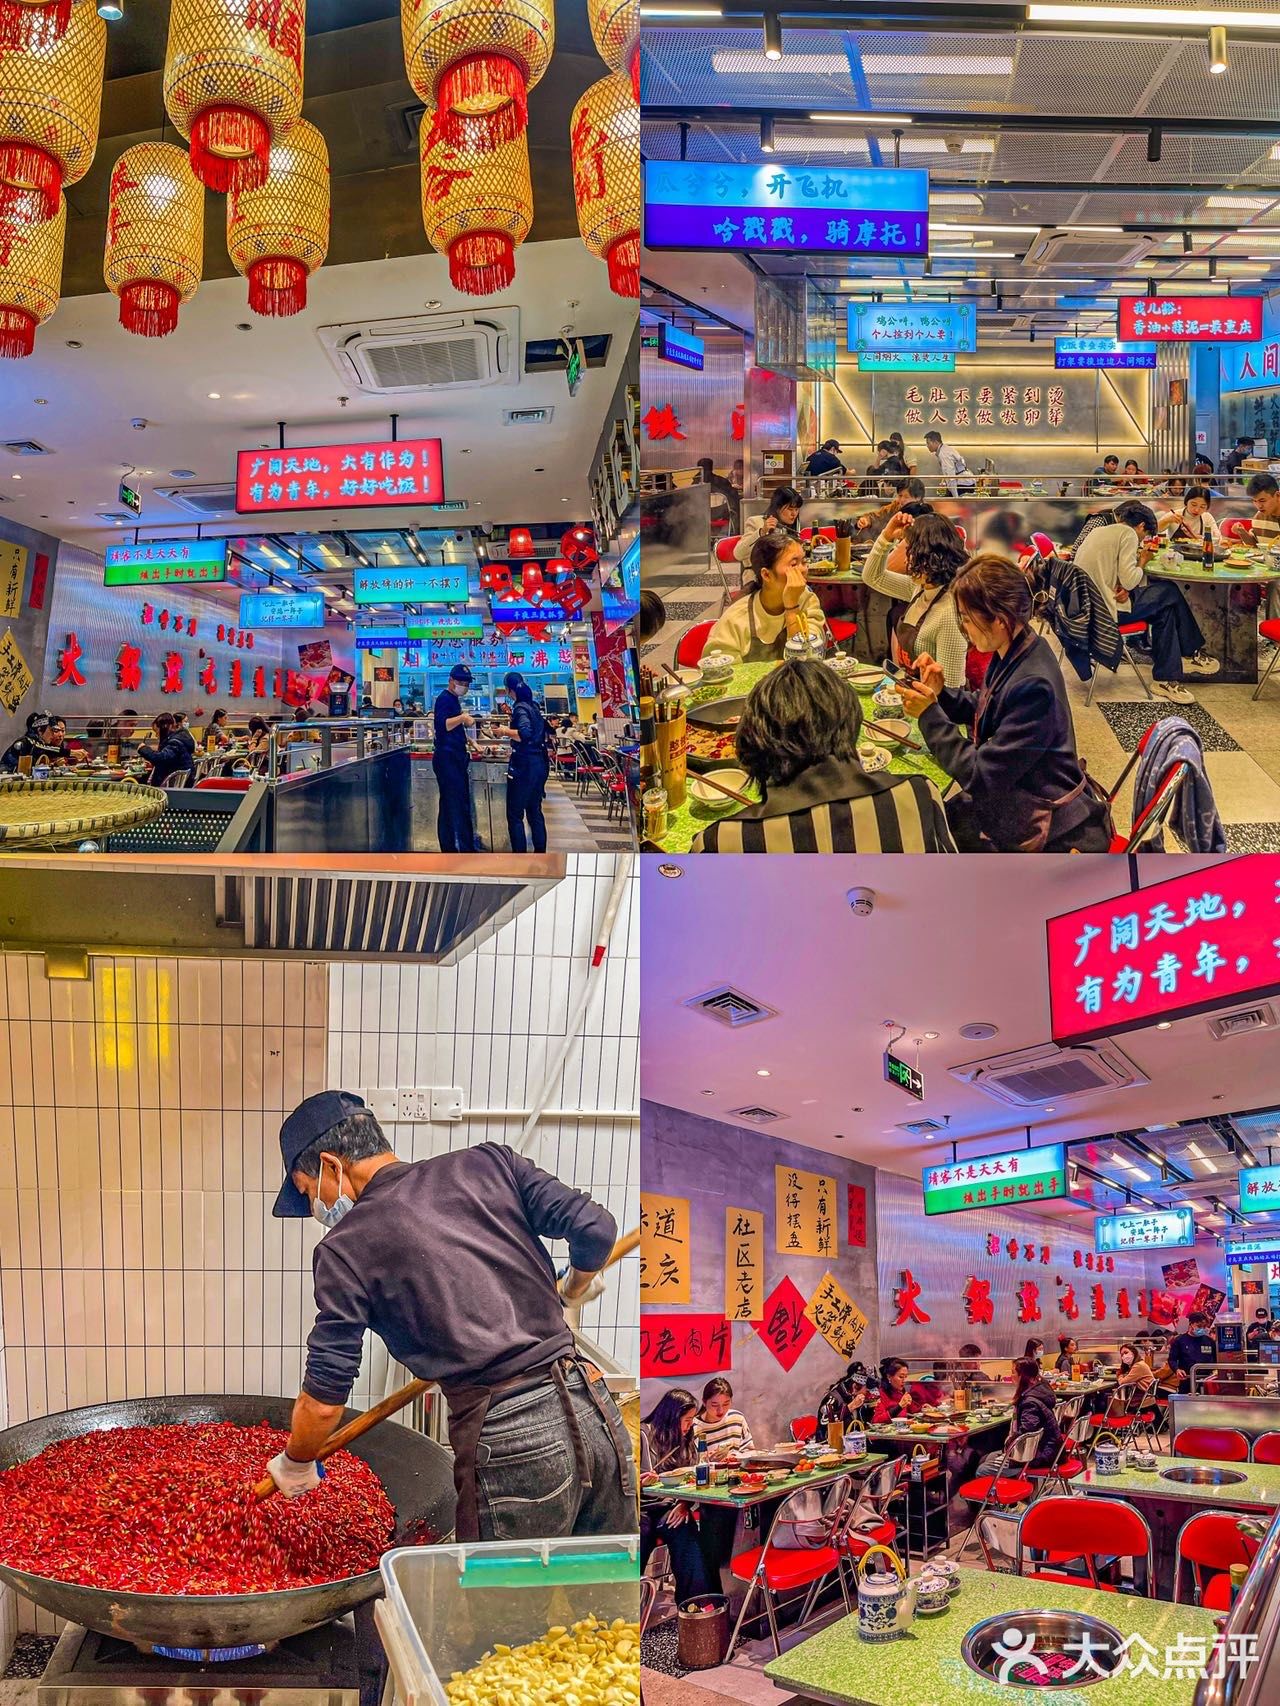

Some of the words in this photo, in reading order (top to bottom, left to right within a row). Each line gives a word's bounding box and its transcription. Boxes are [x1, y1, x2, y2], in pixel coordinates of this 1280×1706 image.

[906, 386, 1065, 406] 毛肚不要紧到烫
[249, 449, 430, 478] 广阔天地，大有作为！
[249, 475, 431, 503] 有为青年，好好吃饭！
[110, 546, 190, 562] 请客不是天天有
[927, 1157, 1019, 1186] 请客不是天天有
[785, 1172, 803, 1250] 没得摆盘
[815, 1179, 832, 1257] 只有新鲜
[733, 1213, 756, 1320] 社区老店
